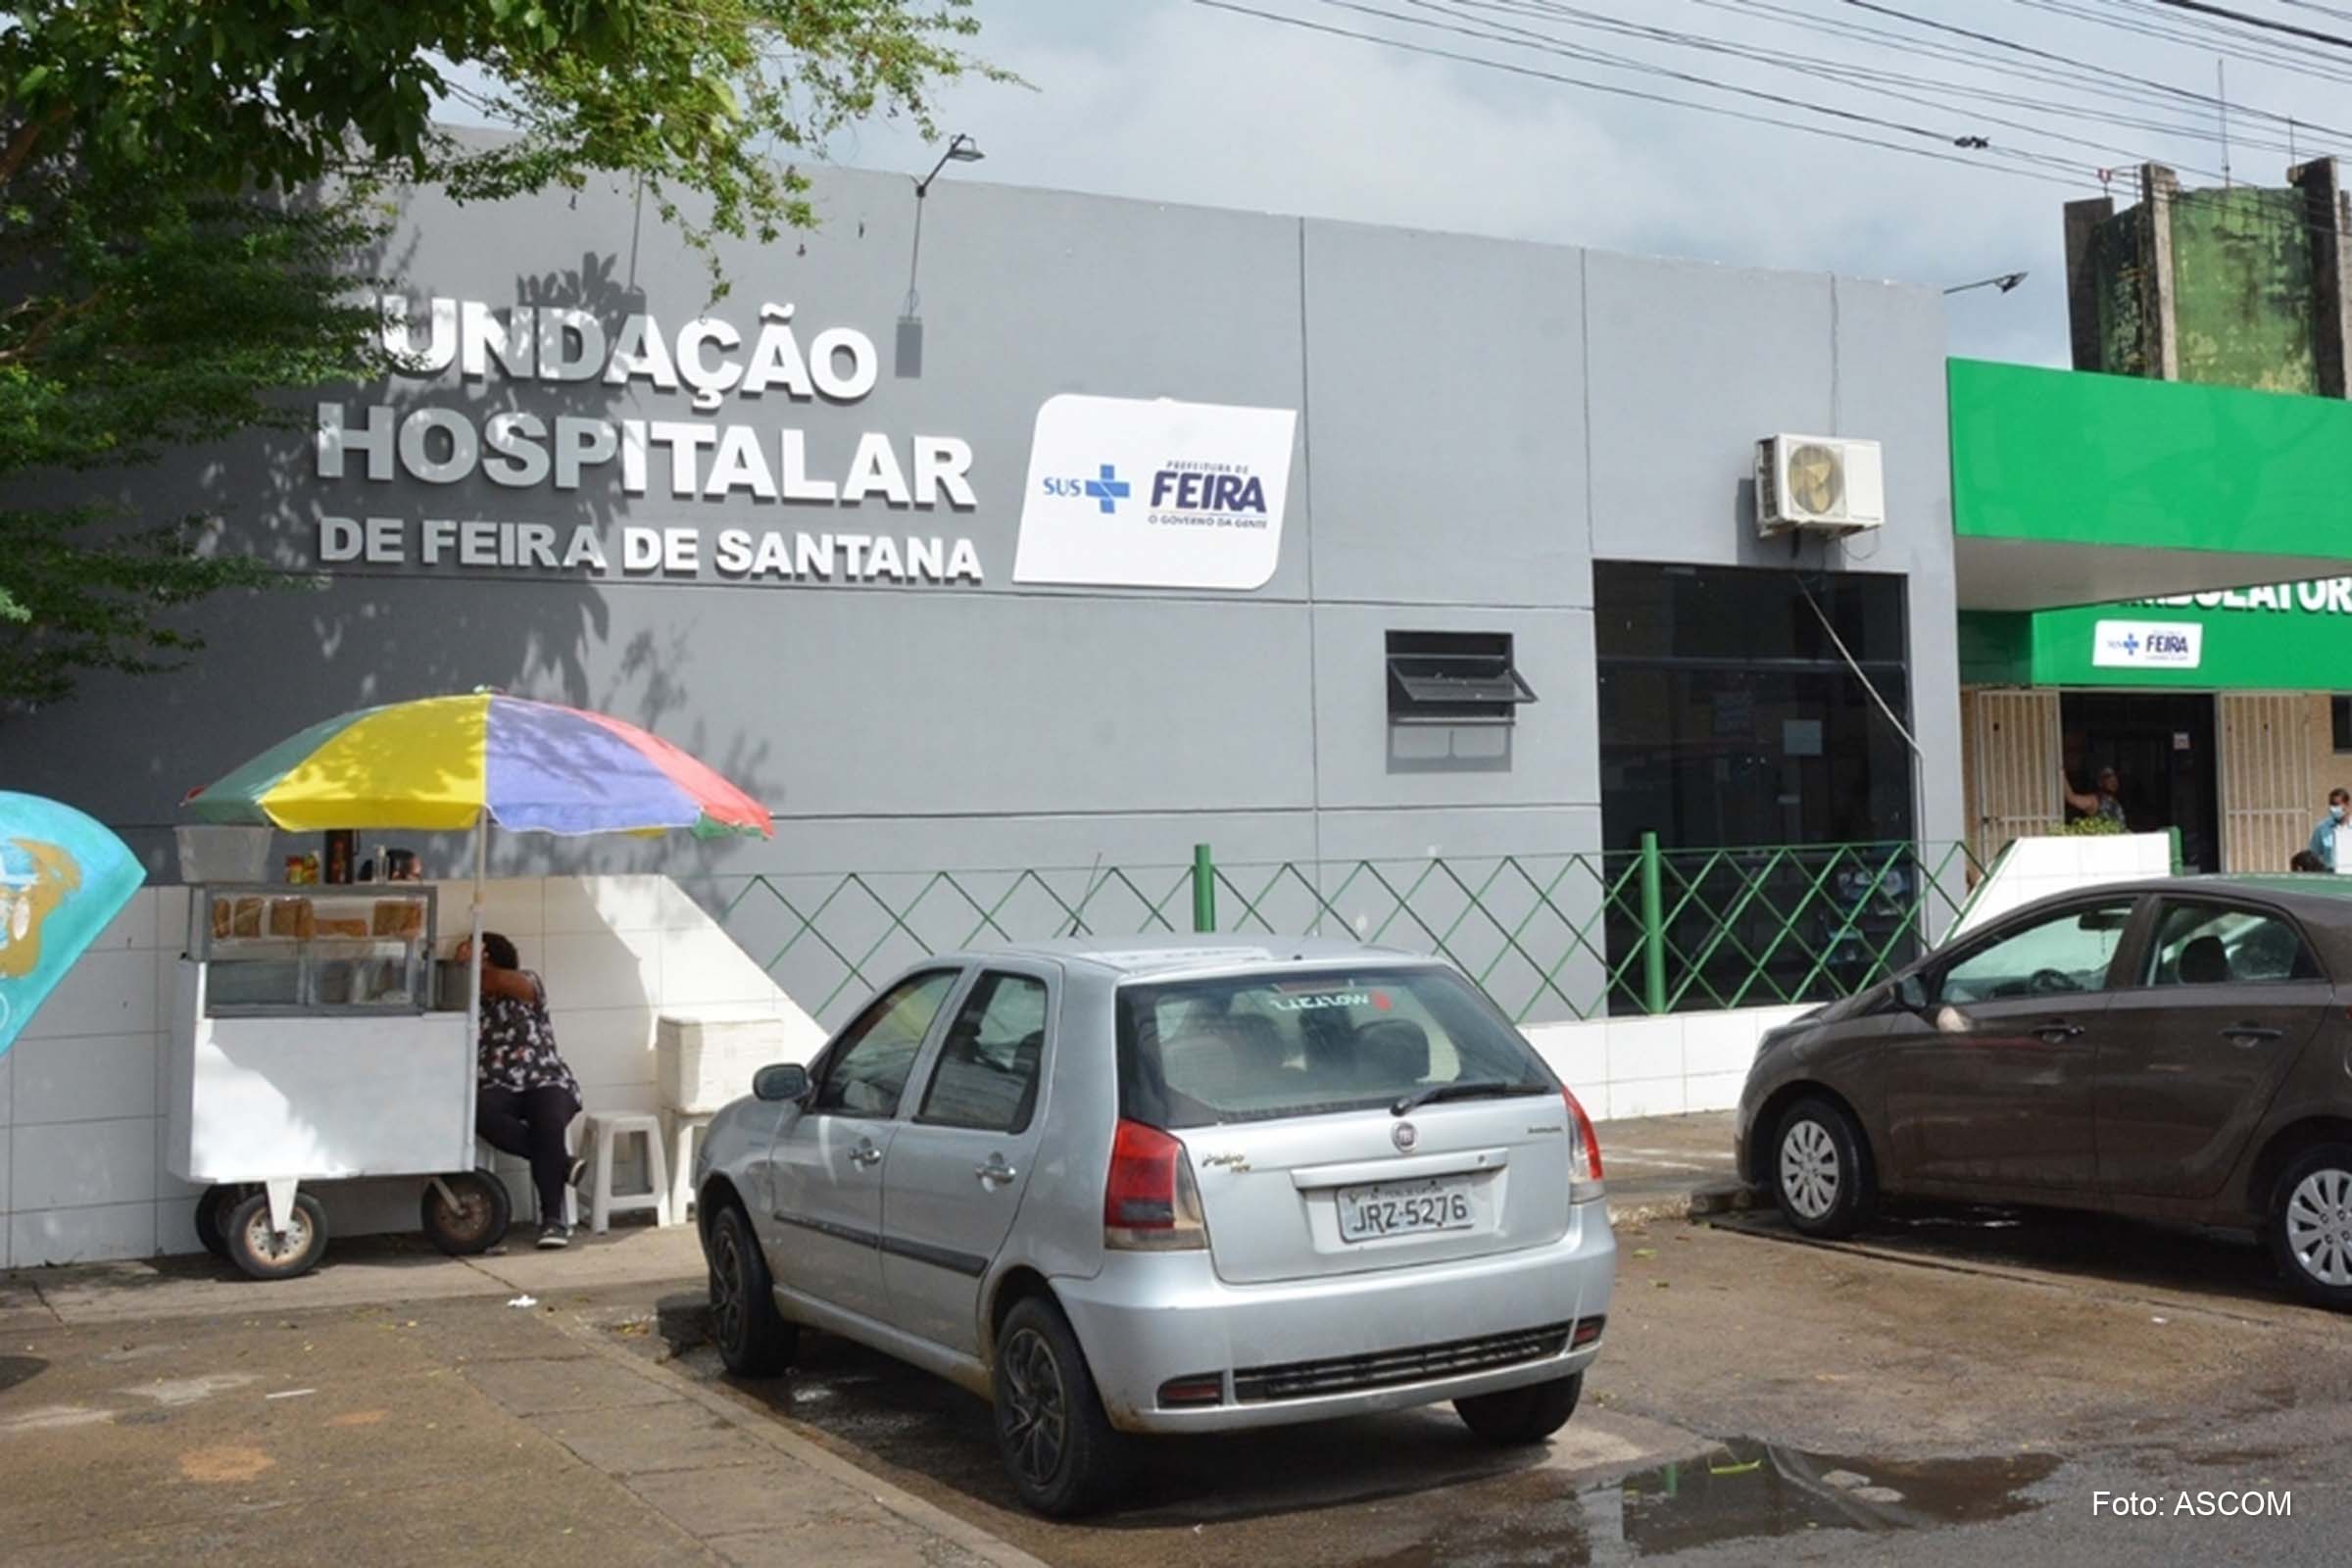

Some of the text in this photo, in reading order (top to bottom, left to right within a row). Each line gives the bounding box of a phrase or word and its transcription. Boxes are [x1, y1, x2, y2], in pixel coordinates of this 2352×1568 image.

[316, 400, 979, 507] HOSPITALAR
[1043, 476, 1081, 497] SUS
[1151, 470, 1267, 514] FEIRA
[319, 514, 983, 582] DE FEIRA DE SANTANA
[2145, 635, 2188, 654] FEIRA
